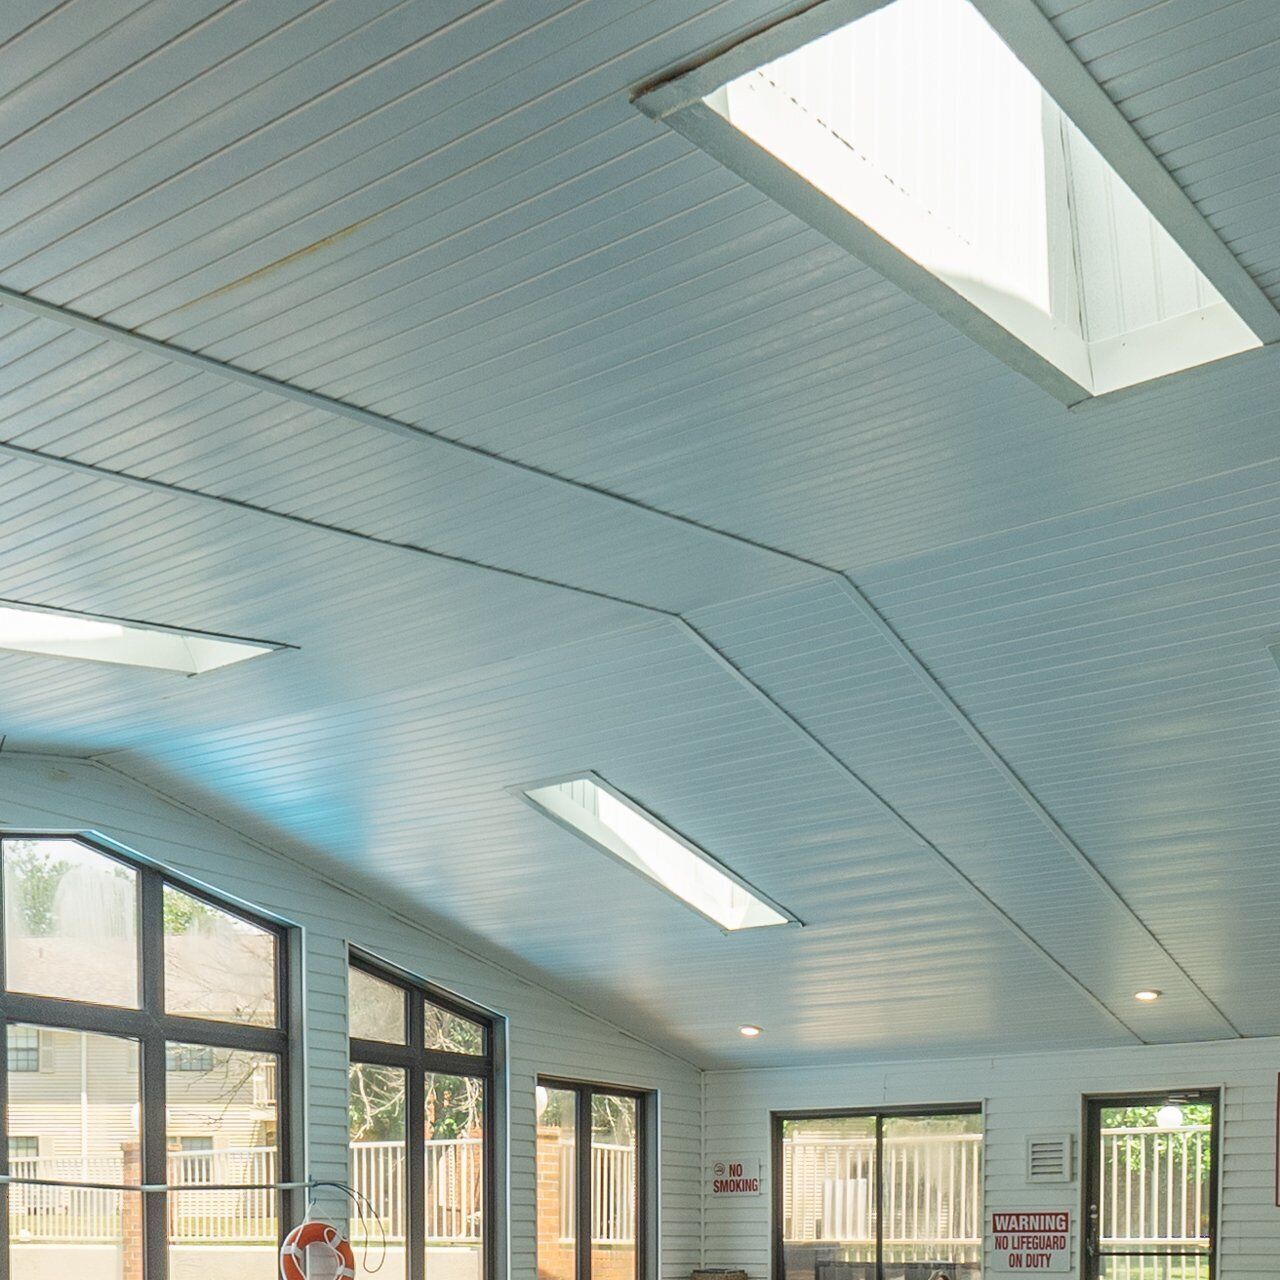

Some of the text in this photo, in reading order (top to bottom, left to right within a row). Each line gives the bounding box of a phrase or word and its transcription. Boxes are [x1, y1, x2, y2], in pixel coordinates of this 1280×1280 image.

[729, 1163, 743, 1177] NO
[713, 1178, 758, 1192] SMOKING
[995, 1215, 1066, 1230] WARNING
[995, 1236, 1066, 1250] NO LIFEGUARD
[1009, 1254, 1051, 1268] ON DUTY
